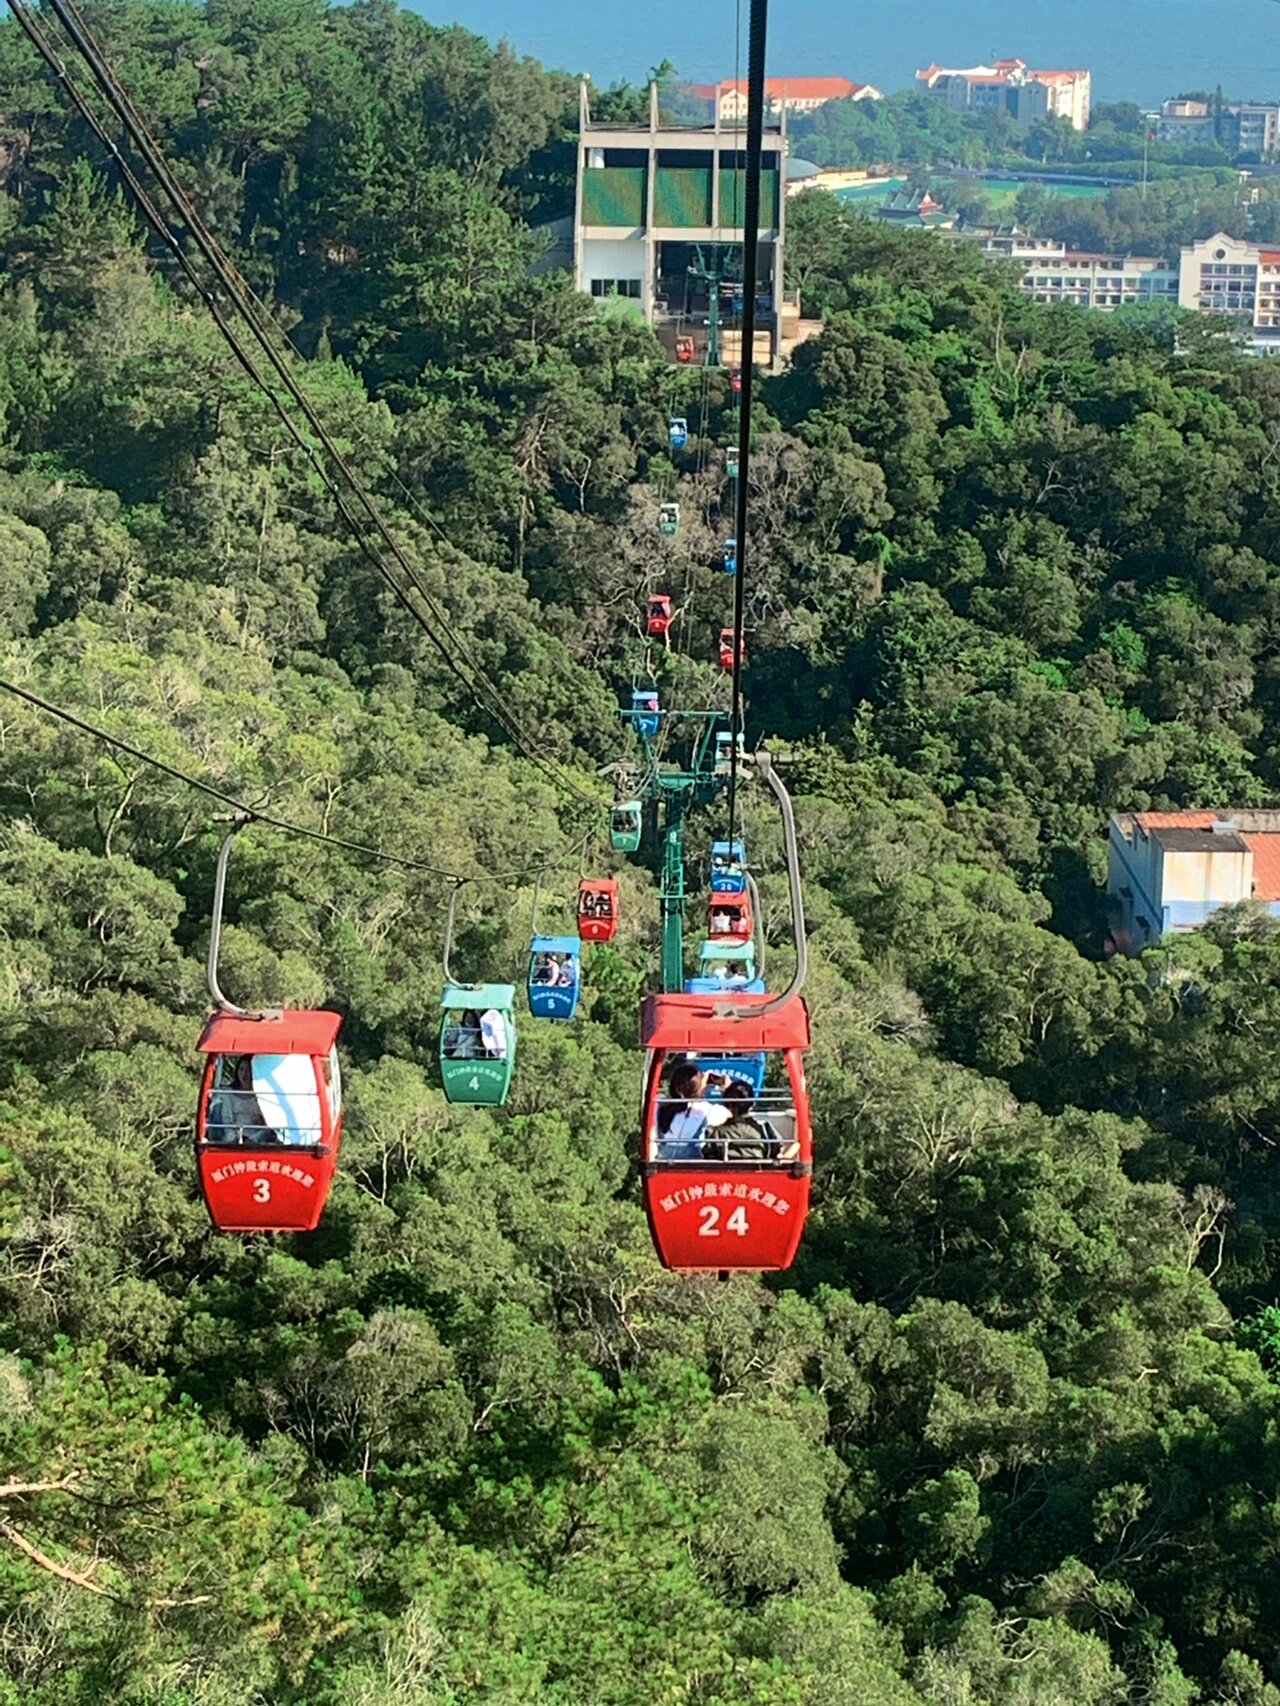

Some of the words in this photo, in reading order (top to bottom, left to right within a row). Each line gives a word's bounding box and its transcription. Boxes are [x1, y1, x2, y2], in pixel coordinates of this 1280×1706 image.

[468, 1076, 480, 1091] 4
[253, 1178, 270, 1203] 3
[699, 1205, 749, 1236] 24
